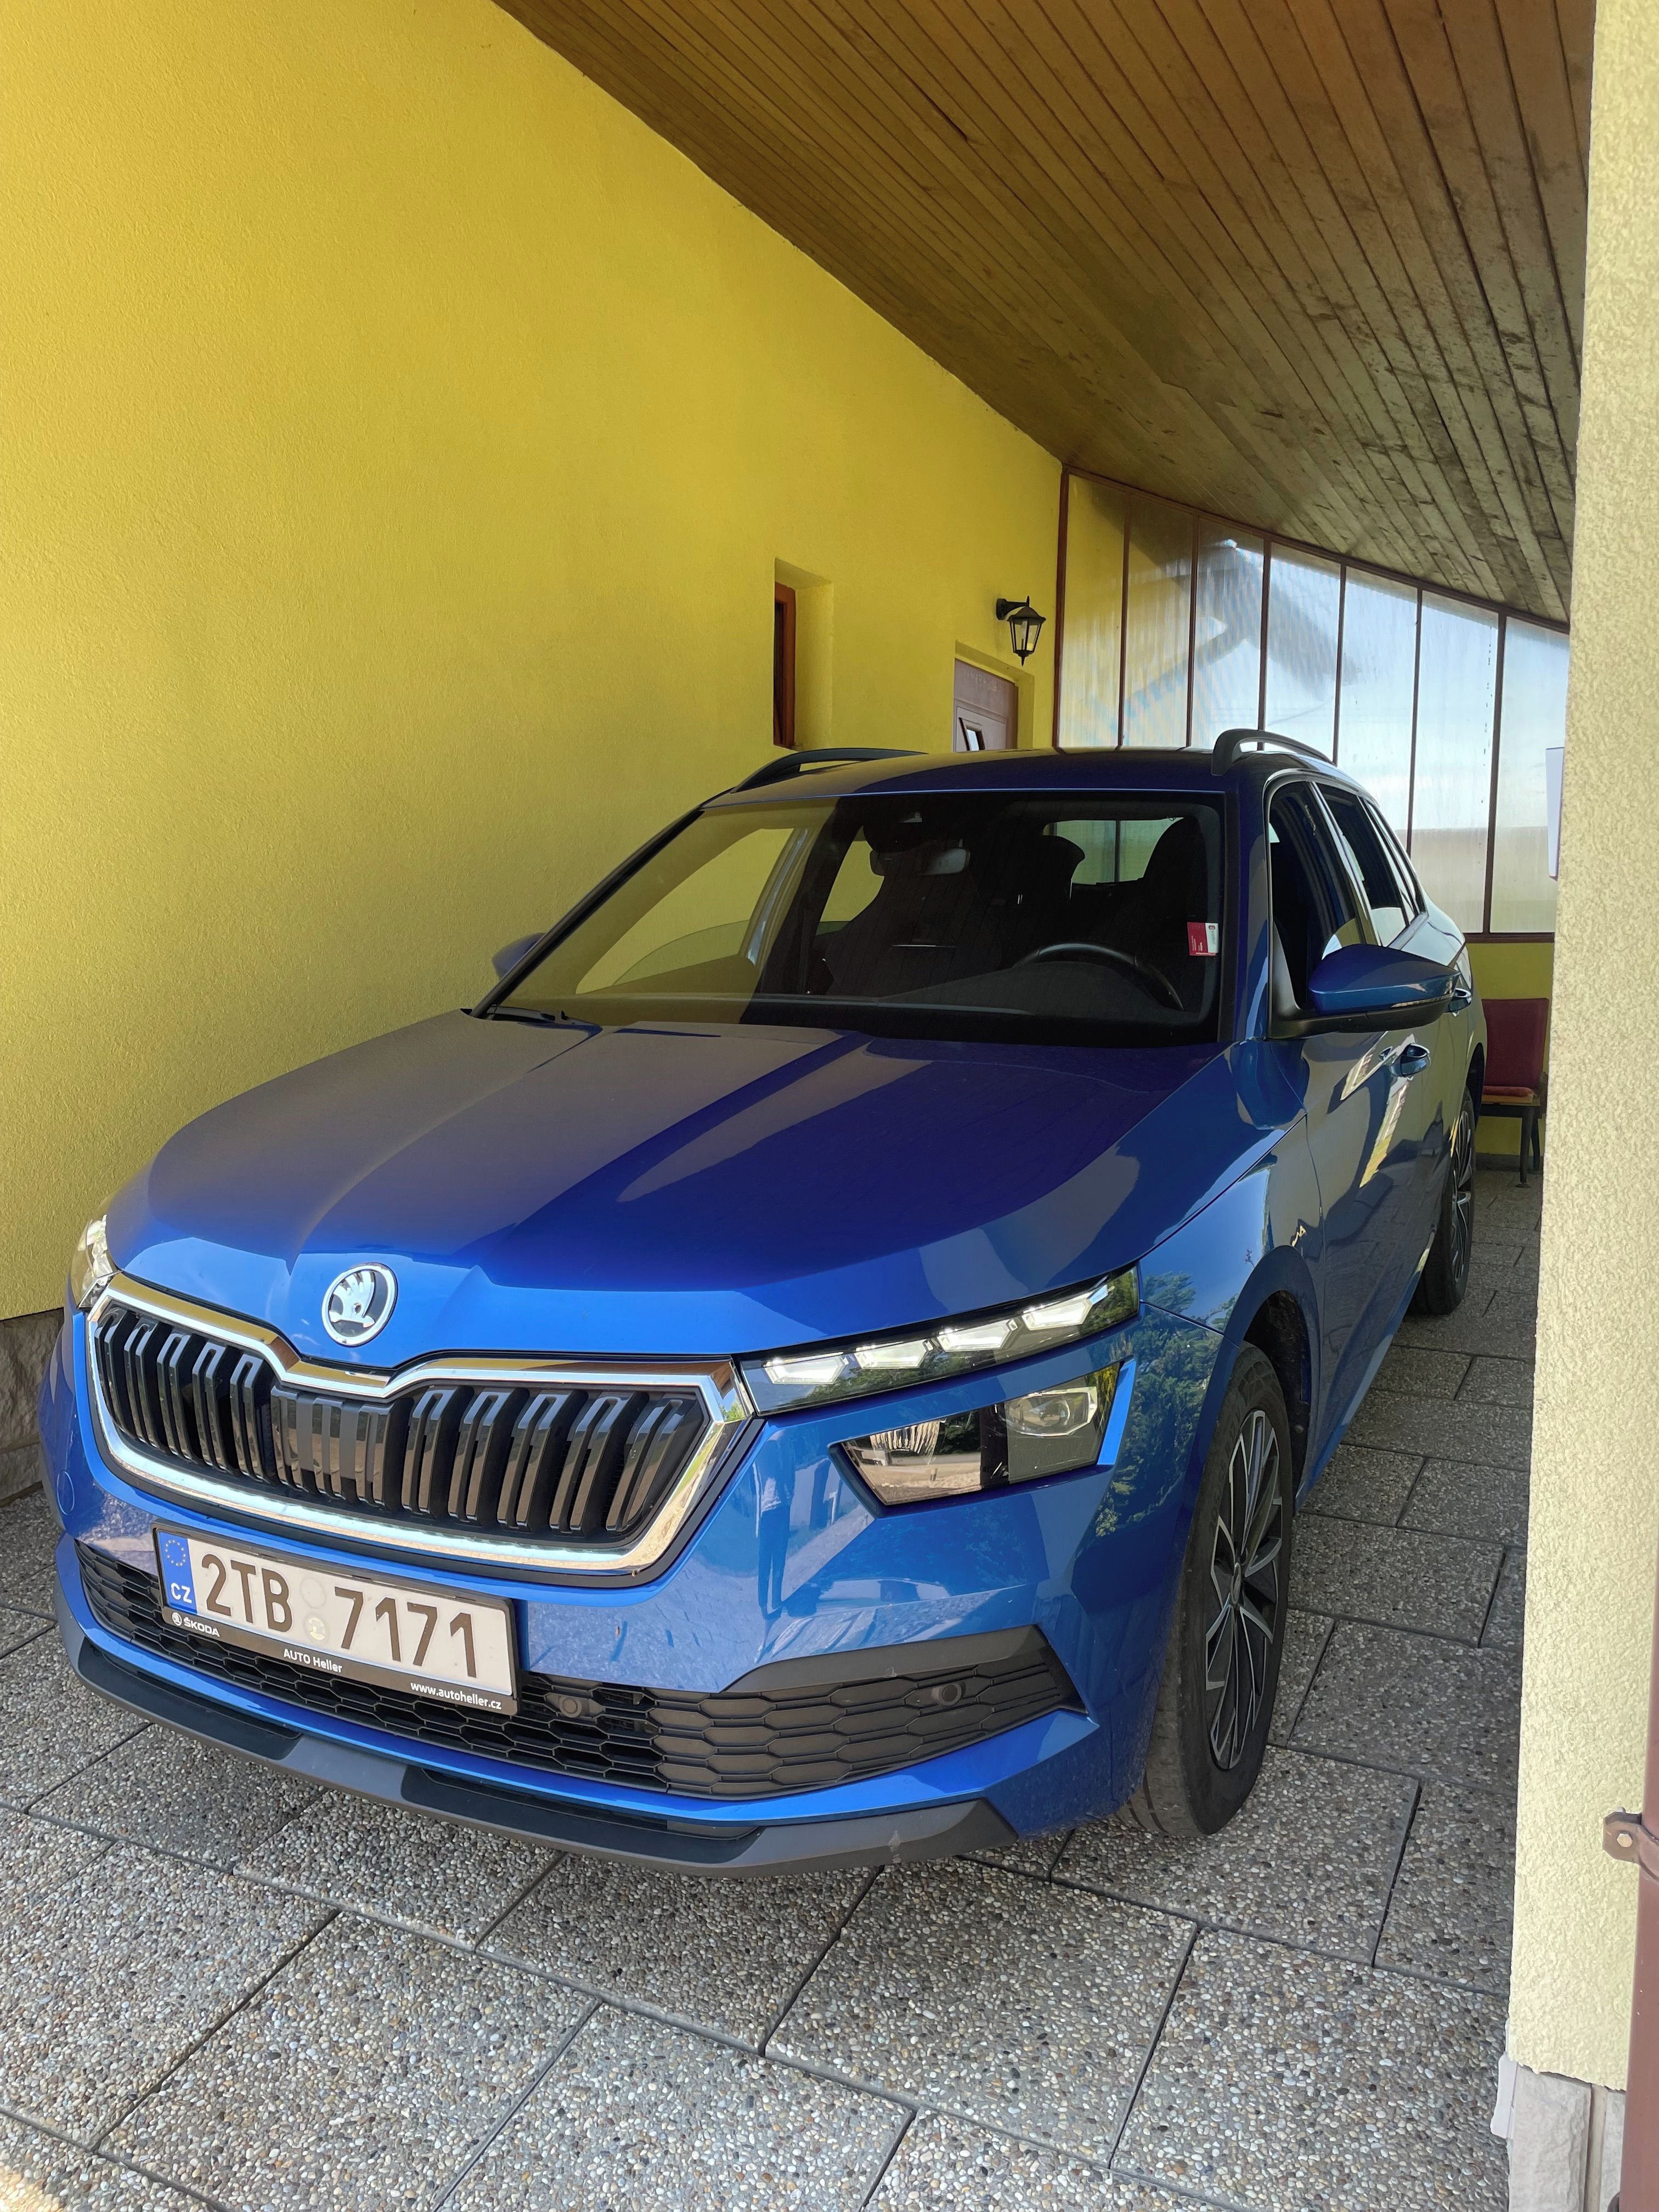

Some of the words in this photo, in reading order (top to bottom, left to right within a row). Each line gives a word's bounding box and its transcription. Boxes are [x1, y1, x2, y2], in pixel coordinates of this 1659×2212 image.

[171, 1583, 192, 1604] CZ
[183, 1617, 220, 1637] ŠKODA
[201, 1554, 292, 1632] 2TB
[335, 1586, 477, 1678] 7171
[284, 1649, 311, 1664] AUTO
[313, 1657, 342, 1673] Heller
[410, 1682, 501, 1709] www.autoheller.cz
